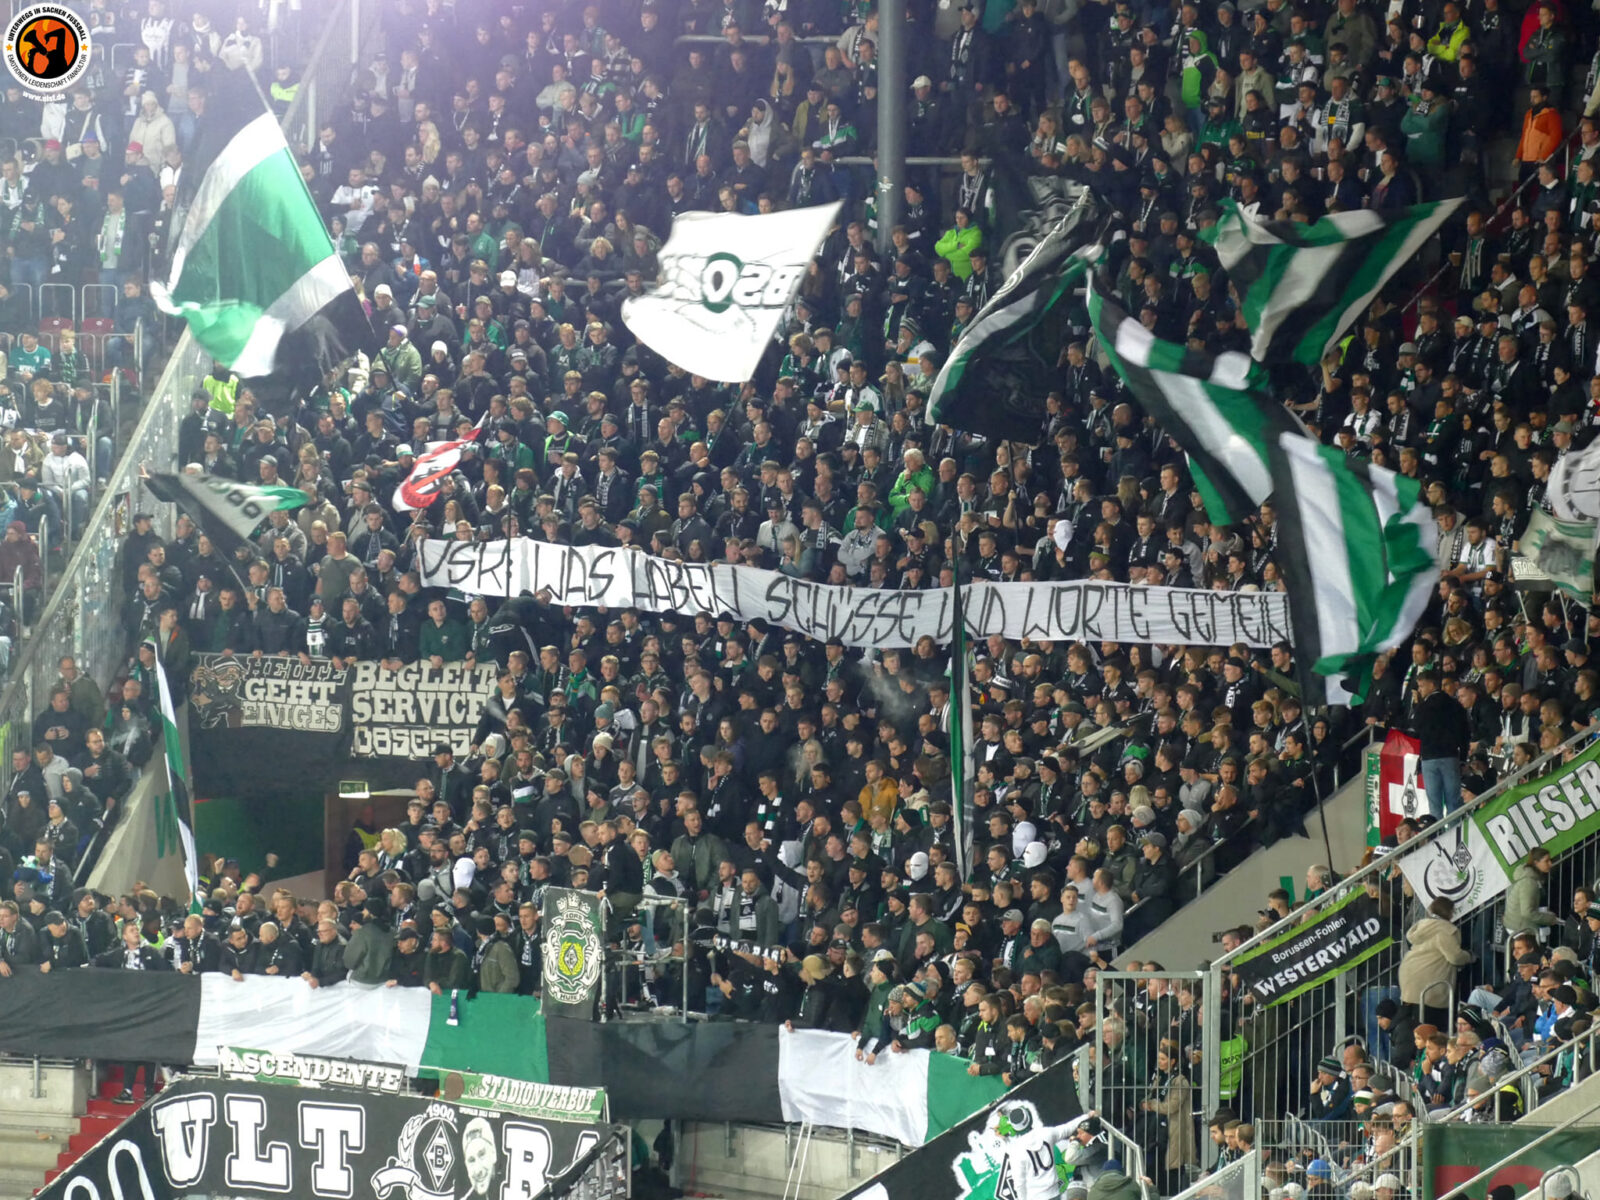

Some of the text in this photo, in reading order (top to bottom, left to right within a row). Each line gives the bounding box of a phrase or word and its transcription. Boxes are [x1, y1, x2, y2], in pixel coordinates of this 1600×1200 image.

[533, 543, 615, 603] WAS
[631, 550, 742, 618] HABEN
[765, 575, 923, 644] SCHÜSSE
[936, 585, 1006, 639] UND
[1022, 585, 1150, 640] WORTE
[246, 656, 350, 686] HEUTE
[244, 679, 336, 707] GEHT
[352, 689, 487, 725] SERVICE
[241, 701, 343, 733] EINIGES
[1253, 917, 1381, 997] WESTERWALD
[1272, 916, 1347, 964] Borussen-Fohlen
[222, 1047, 403, 1095] ASCENDENTE
[481, 1074, 597, 1112] STADIONVERBOT
[427, 1104, 453, 1121] 1900
[1026, 1140, 1054, 1177] 10
